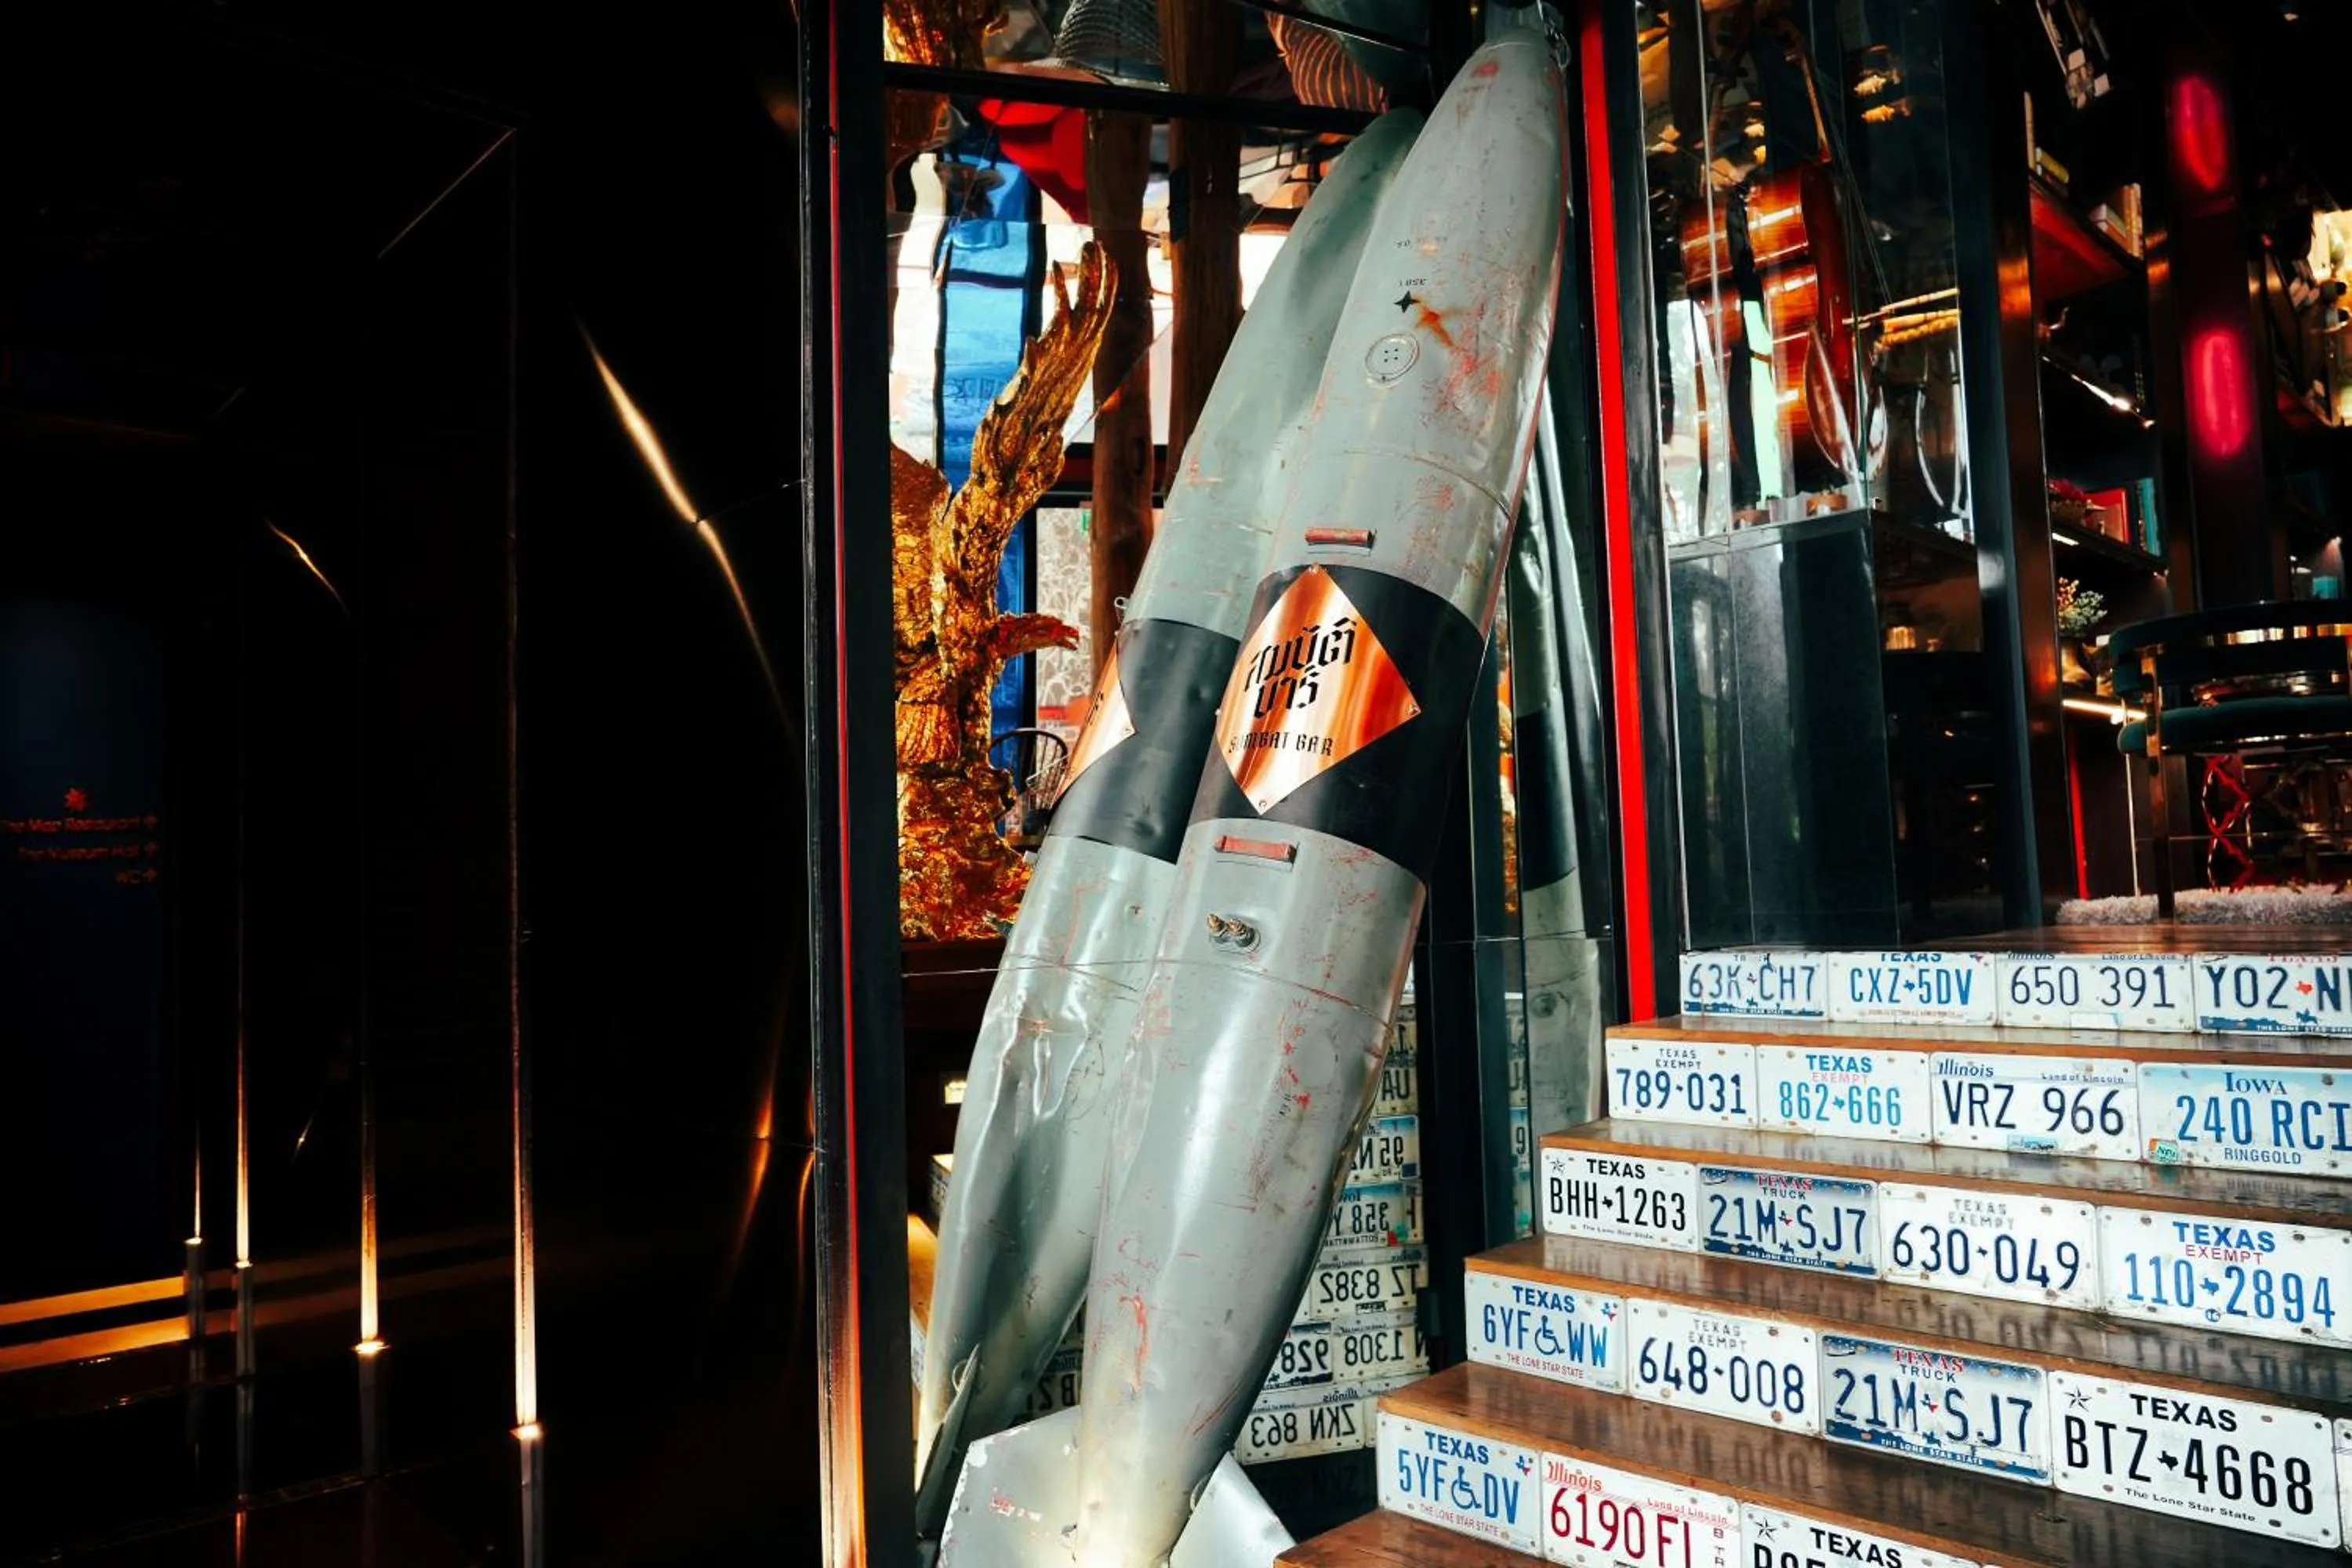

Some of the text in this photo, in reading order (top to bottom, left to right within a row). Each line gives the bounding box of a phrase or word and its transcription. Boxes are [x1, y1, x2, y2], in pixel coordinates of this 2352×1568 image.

[1295, 735, 1334, 757] BAR
[2011, 965, 2175, 1008] 650 391
[2315, 966, 2352, 1012] N
[1655, 1058, 1702, 1069] EXEMPT
[1658, 1047, 1697, 1059] TEXAS
[1806, 1054, 1872, 1073] TEXAS
[1812, 1071, 1869, 1084] EXEMPT
[1938, 1058, 1994, 1078] Illinois
[1942, 1079, 2125, 1137] VRZ 966
[2176, 1094, 2253, 1145] 240
[2223, 1147, 2302, 1165] RINGGOLD
[1586, 1158, 1646, 1179] TEXAS
[1757, 1174, 1813, 1191] TEXAS
[1762, 1186, 1806, 1200] TRUCK
[1953, 1198, 2007, 1215] TEXAS
[2172, 1221, 2276, 1253] TEXAS
[2185, 1244, 2264, 1265] EXEMPT
[1512, 1285, 1576, 1313] TEXAS
[1483, 1303, 1531, 1350] 6YF
[1693, 1318, 1741, 1337] TEXAS
[1688, 1332, 1748, 1352] EXEMPT
[1522, 1356, 1541, 1369] LONE
[1541, 1360, 1561, 1374] STAR
[1561, 1364, 1584, 1379] STATE
[1893, 1347, 1964, 1373] TEXAS
[1900, 1363, 1957, 1384] TRUCK
[2129, 1392, 2238, 1433] TEXAS
[1424, 1430, 1490, 1465] TEXAS
[1398, 1448, 1519, 1526] 5YF DV
[1547, 1461, 1602, 1491] Illinois
[2125, 1486, 2257, 1523] The Lone Star State
[1551, 1486, 1646, 1560] 6190
[1809, 1526, 1903, 1568] TEXAS
